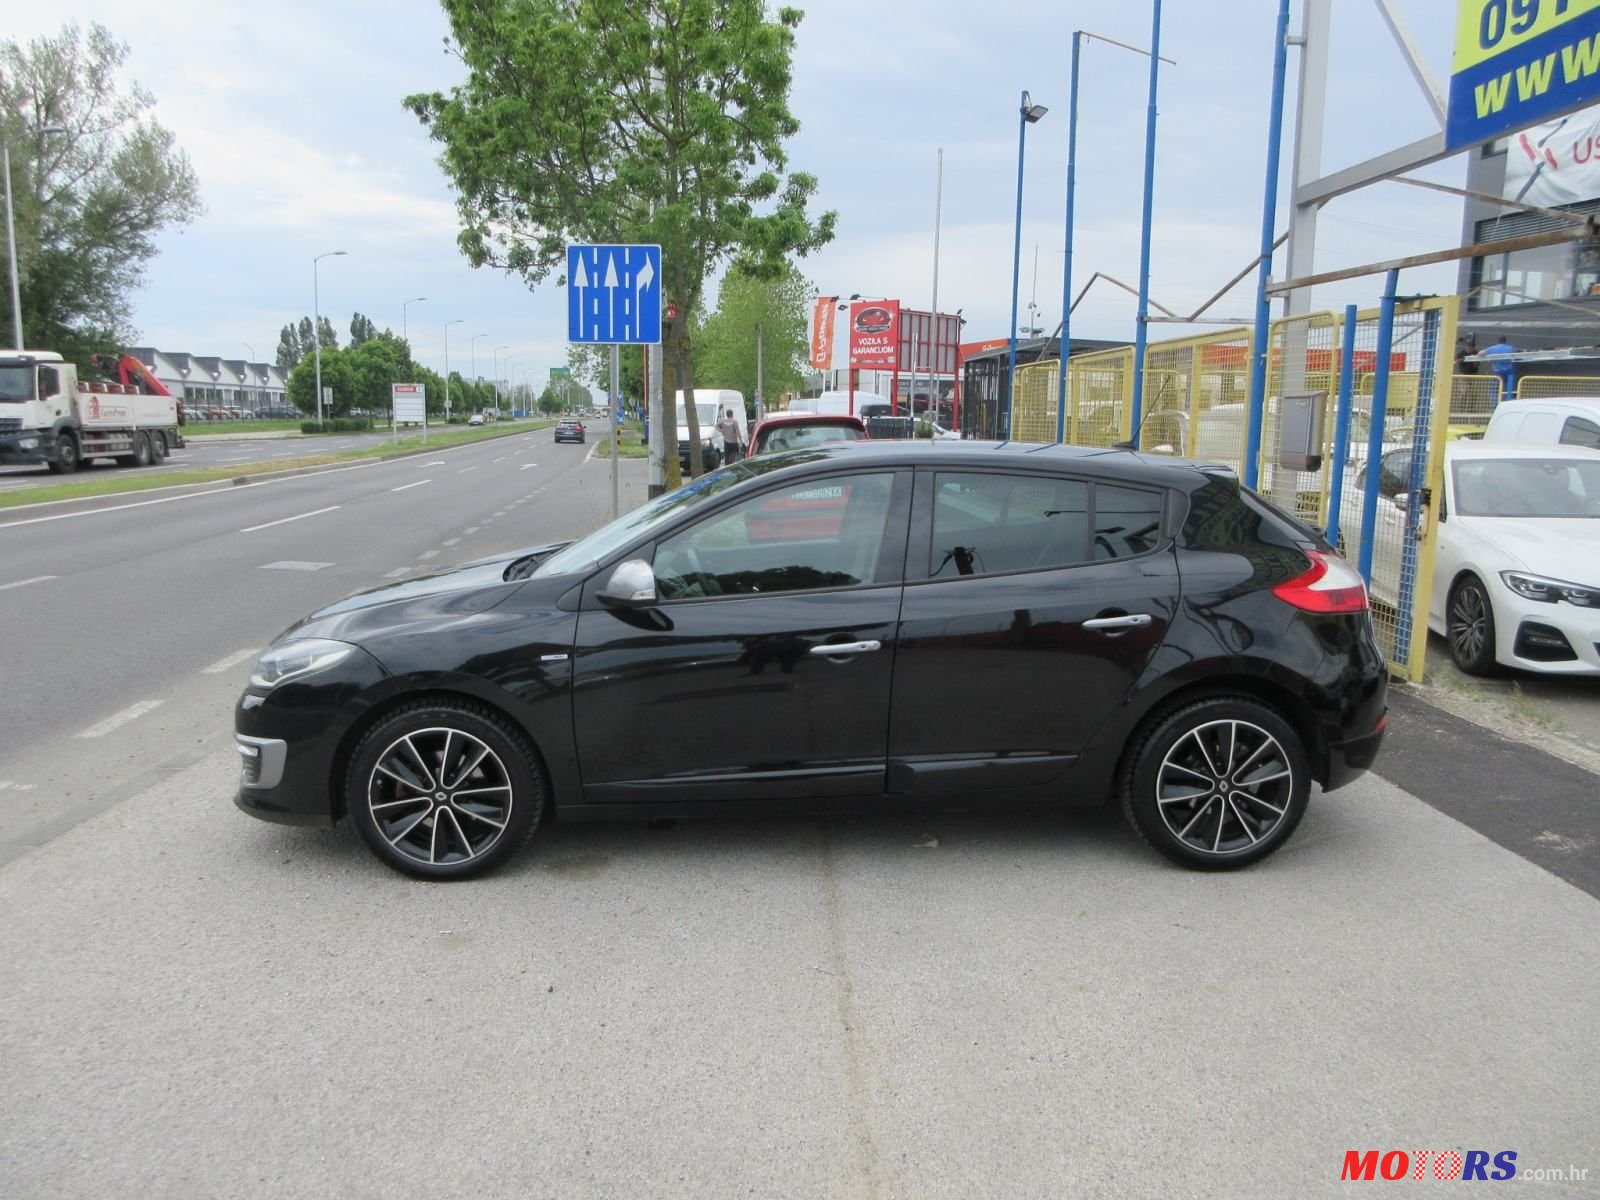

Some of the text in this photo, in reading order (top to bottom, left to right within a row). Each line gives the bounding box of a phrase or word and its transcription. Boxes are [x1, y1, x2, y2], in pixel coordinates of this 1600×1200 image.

[1479, 0, 1568, 50] 09
[858, 337, 881, 346] VOZILA
[852, 346, 894, 355] GARANCIJOM
